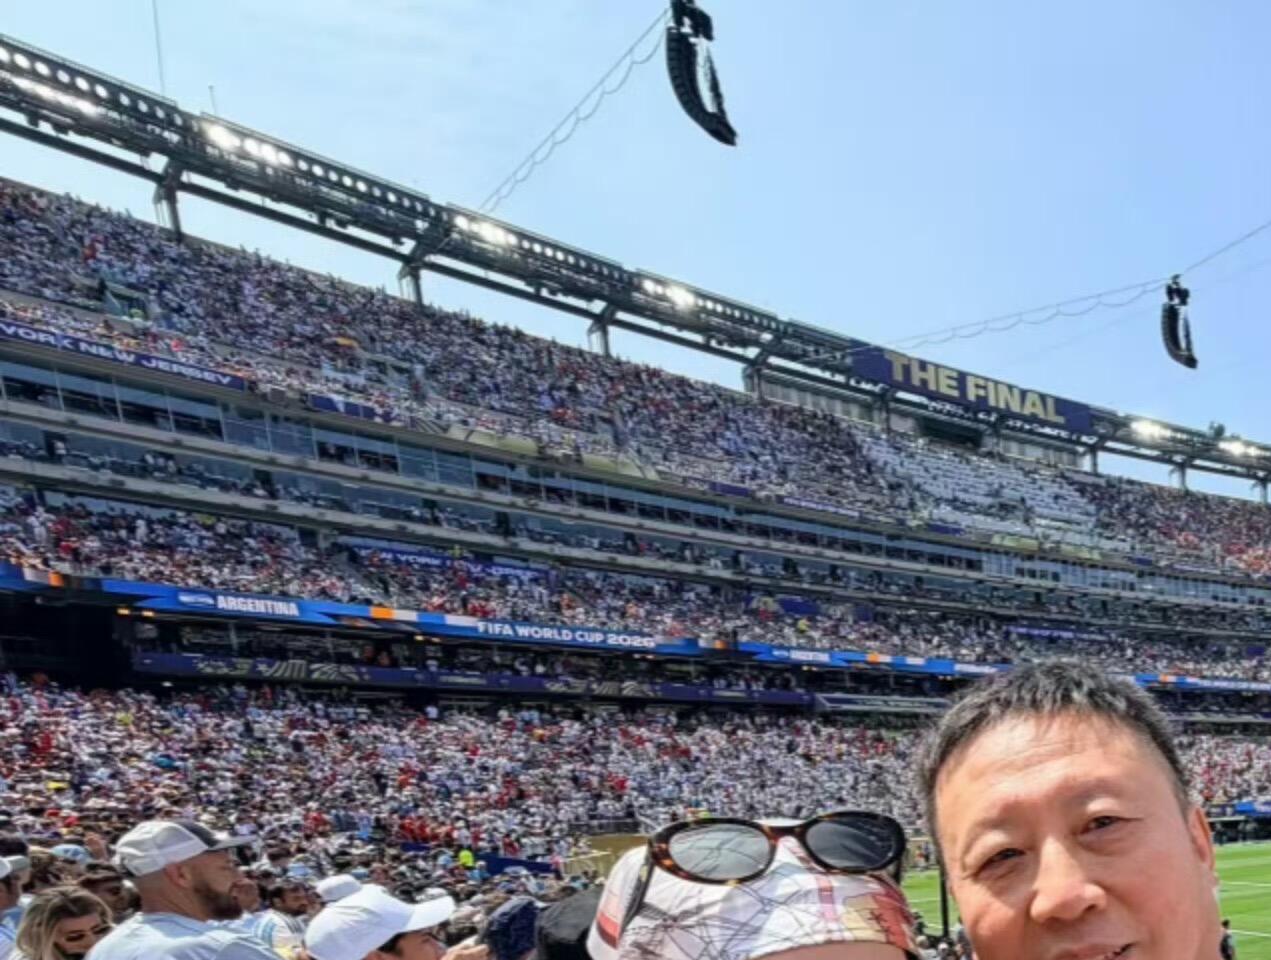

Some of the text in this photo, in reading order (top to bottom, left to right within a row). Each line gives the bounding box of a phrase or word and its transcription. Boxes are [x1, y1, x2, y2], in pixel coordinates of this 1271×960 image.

[79, 342, 136, 364] NEW
[141, 357, 232, 386] JERSEY
[884, 351, 1066, 424] THE FINAL
[216, 595, 300, 617] ARGENTINA
[476, 621, 657, 649] FIFA WORLD CUP 2026
